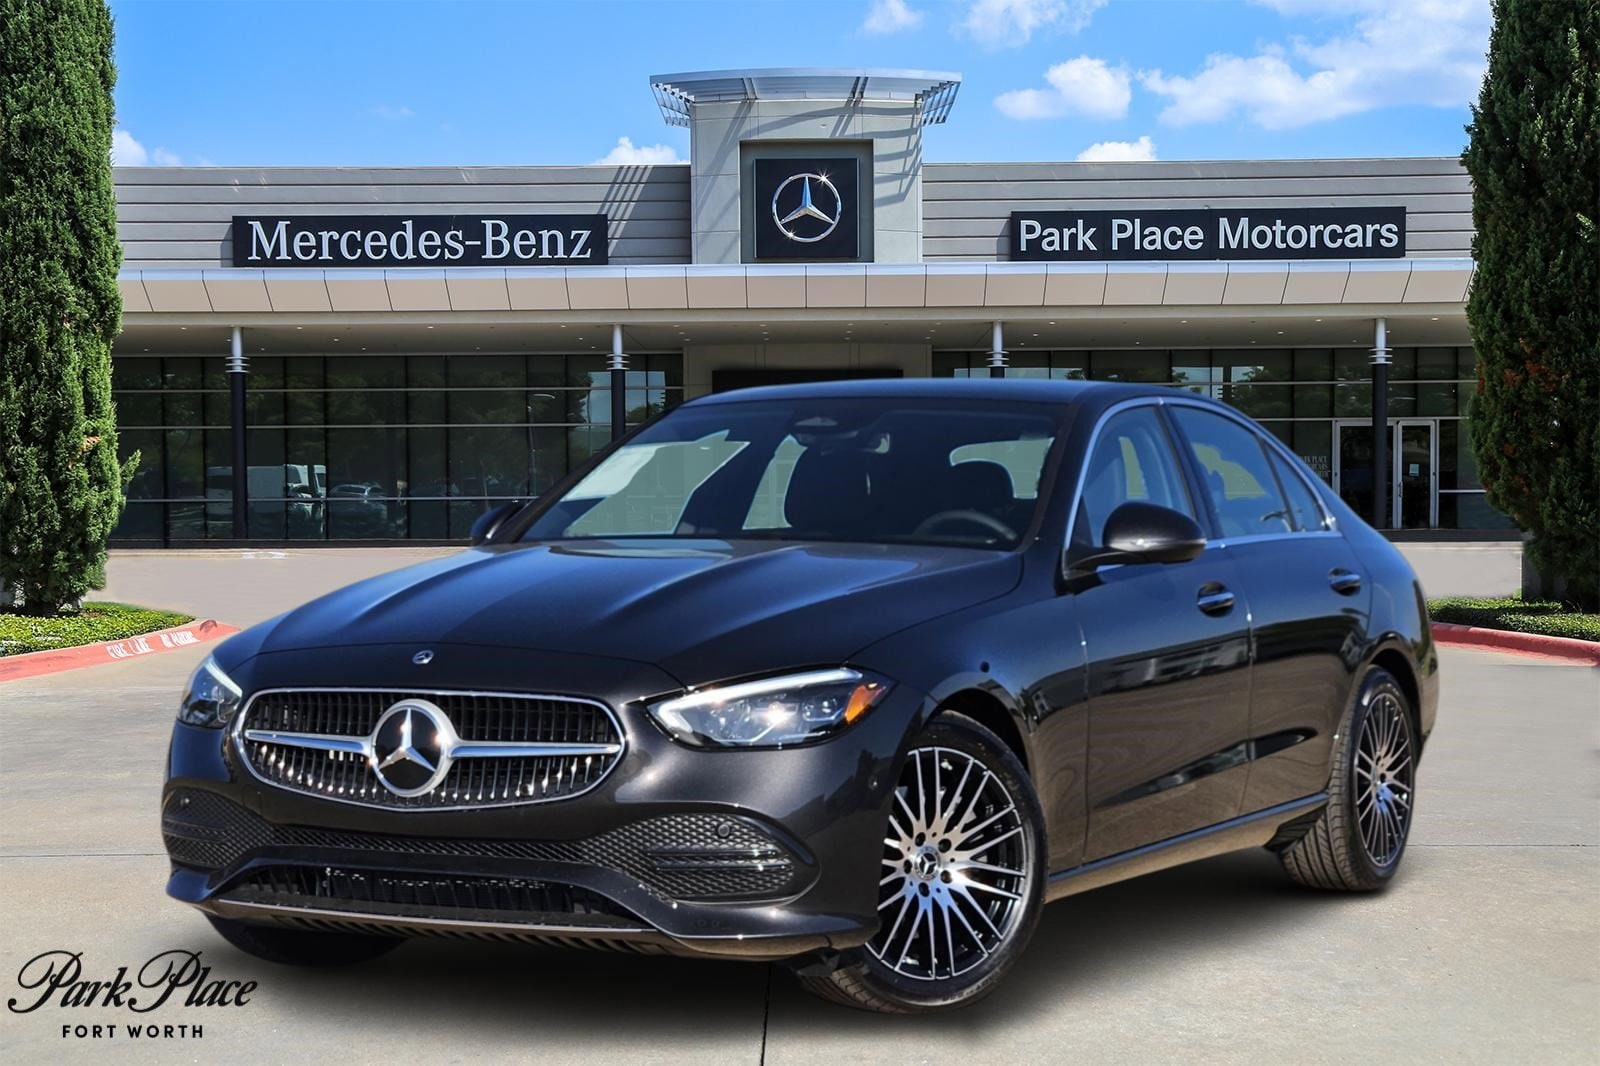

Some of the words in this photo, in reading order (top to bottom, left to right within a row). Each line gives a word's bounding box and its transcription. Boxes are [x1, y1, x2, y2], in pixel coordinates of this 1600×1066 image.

[247, 219, 592, 261] Mercedes-Benz
[1019, 219, 1098, 252] Park
[1111, 217, 1204, 251] Place
[1218, 217, 1399, 250] Motorcars
